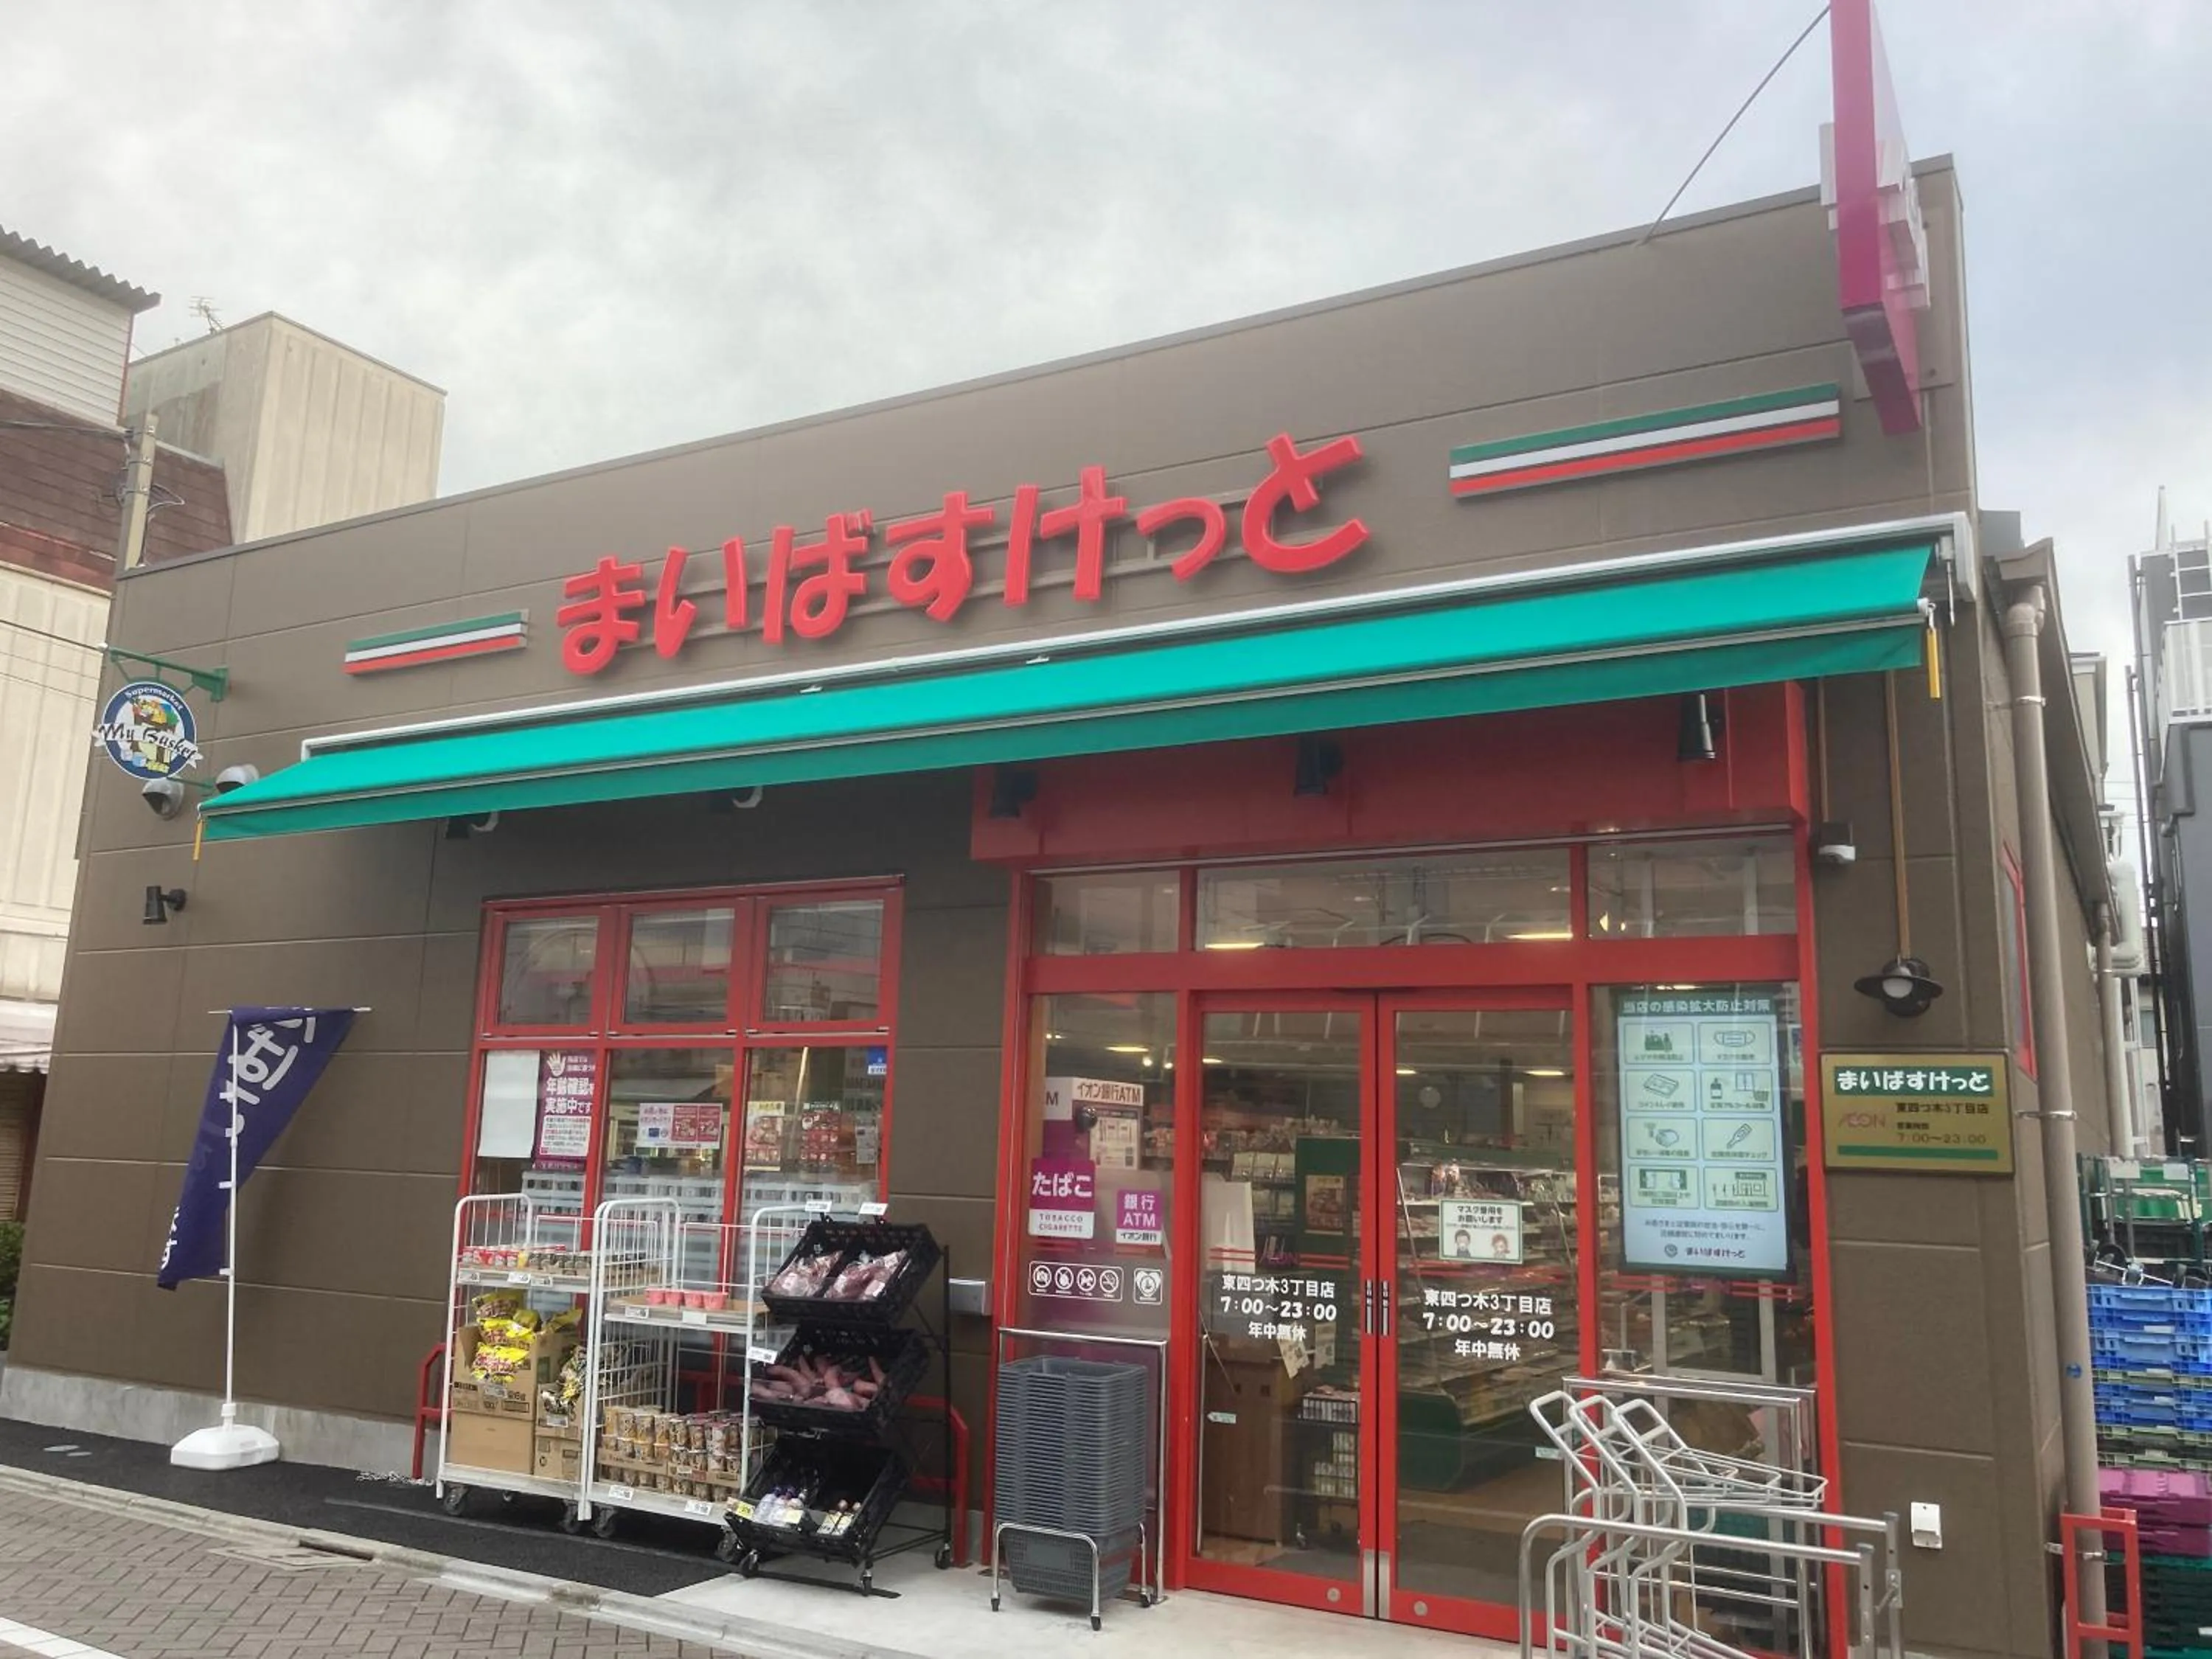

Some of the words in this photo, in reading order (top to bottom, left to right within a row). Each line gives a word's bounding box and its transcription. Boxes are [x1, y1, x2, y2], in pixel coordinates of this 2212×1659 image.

[556, 433, 1370, 675] まいばすけっと
[125, 687, 184, 710] Supermarket
[98, 723, 134, 743] My
[143, 728, 196, 759] Basket
[1837, 1070, 1990, 1092] まいばすけっと
[1077, 1082, 1141, 1103] イオン銀行ATM
[1032, 1172, 1093, 1197] たばこ
[1124, 1194, 1155, 1211] 銀行
[1039, 1213, 1083, 1222] TOBACCO
[1039, 1222, 1082, 1233] CIGARETTE
[1124, 1213, 1155, 1228] ATM
[1121, 1233, 1158, 1242] イオン銀行
[1222, 1274, 1335, 1298] 東四つ木3丁目店
[1424, 1290, 1552, 1315] 東四つ木3丁目店
[1248, 1321, 1307, 1341] 年中無休
[1455, 1339, 1520, 1361] 年中無休
